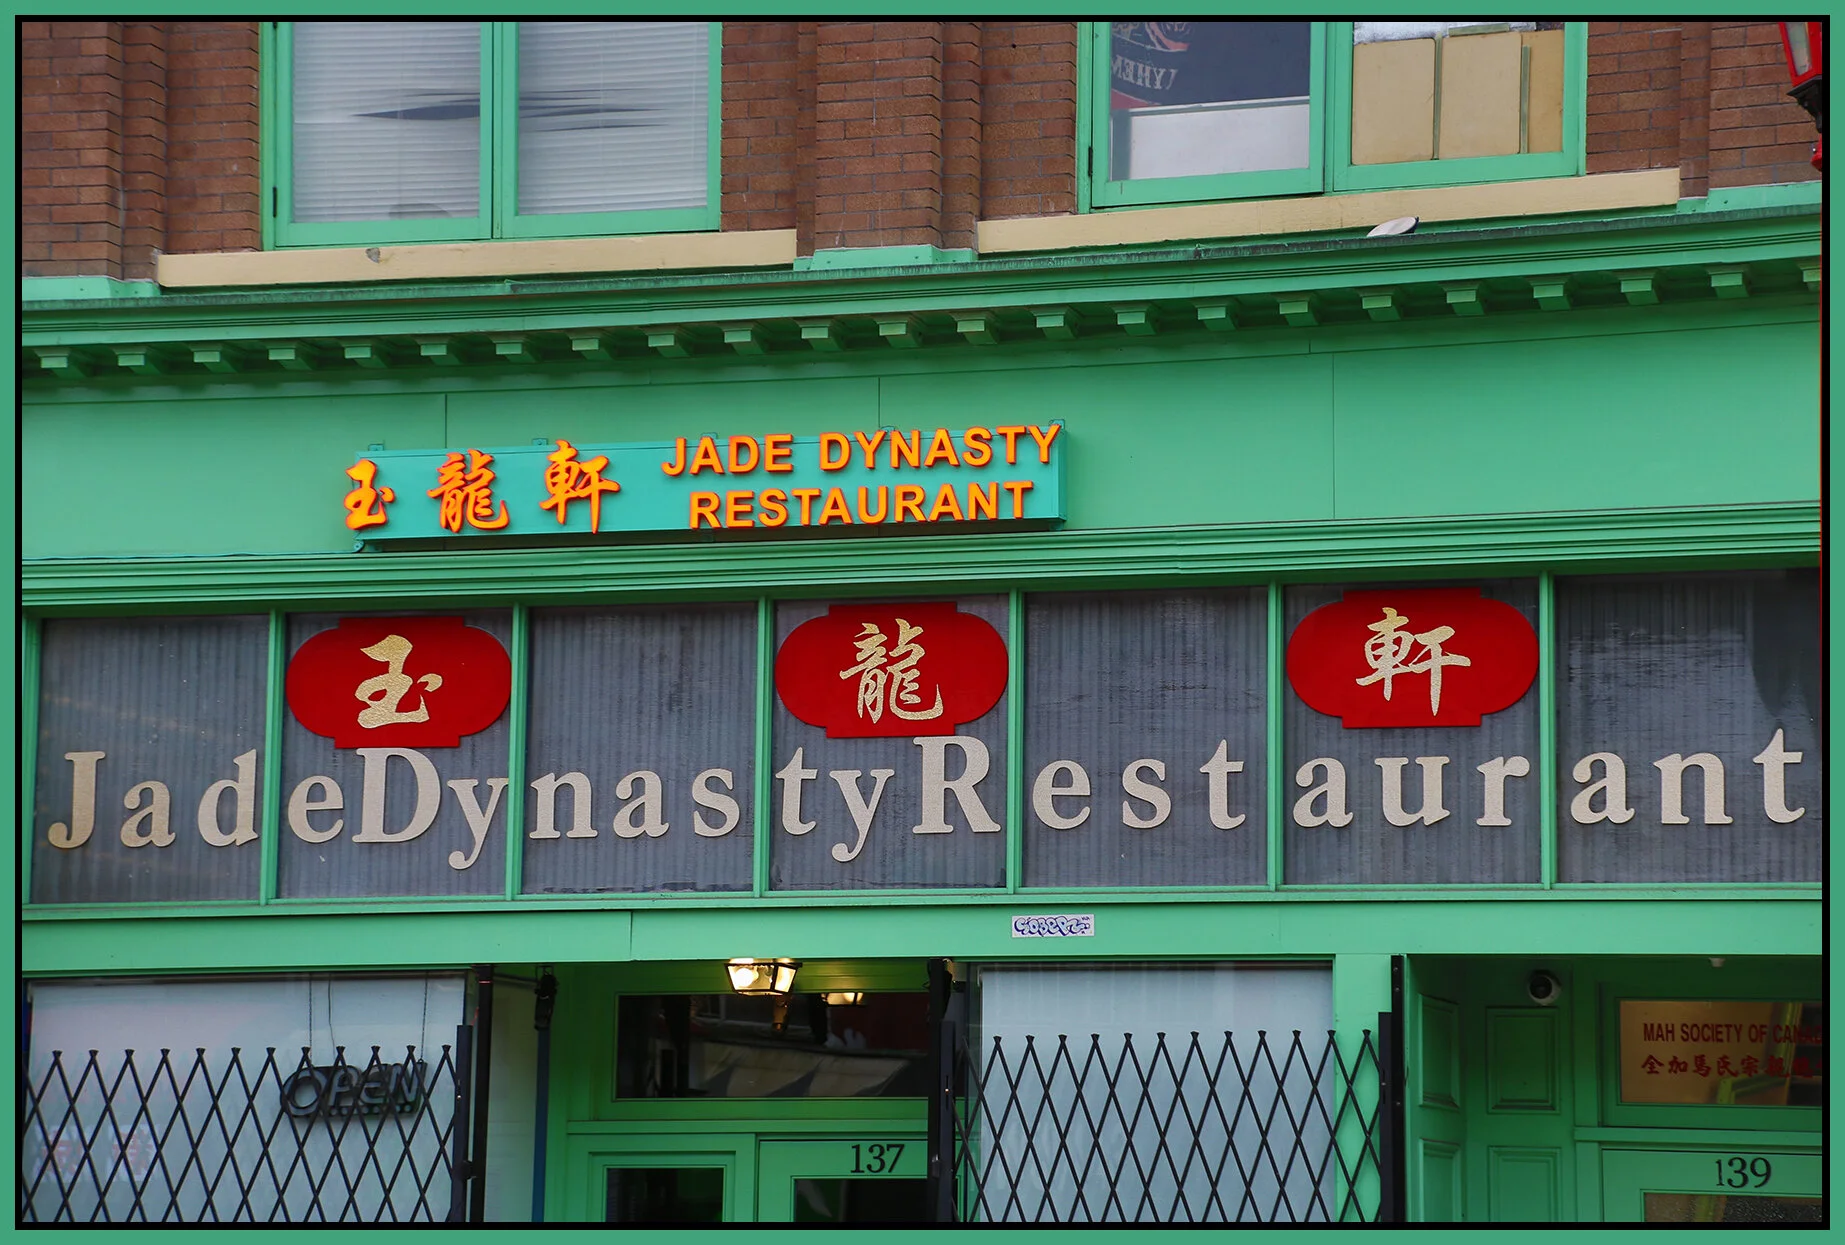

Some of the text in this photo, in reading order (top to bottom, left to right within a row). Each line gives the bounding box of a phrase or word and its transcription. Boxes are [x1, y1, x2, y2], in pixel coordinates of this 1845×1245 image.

[661, 424, 1060, 477] JADE DYNASTY
[689, 480, 1033, 530] RESTAURANT
[355, 607, 1471, 729] 玉 龍 軒
[1643, 1023, 1675, 1042] MAH
[1680, 1023, 1743, 1042] SOCIETY
[1748, 1024, 1768, 1043] OF
[850, 1144, 904, 1173] 137
[1716, 1157, 1771, 1188] 139
